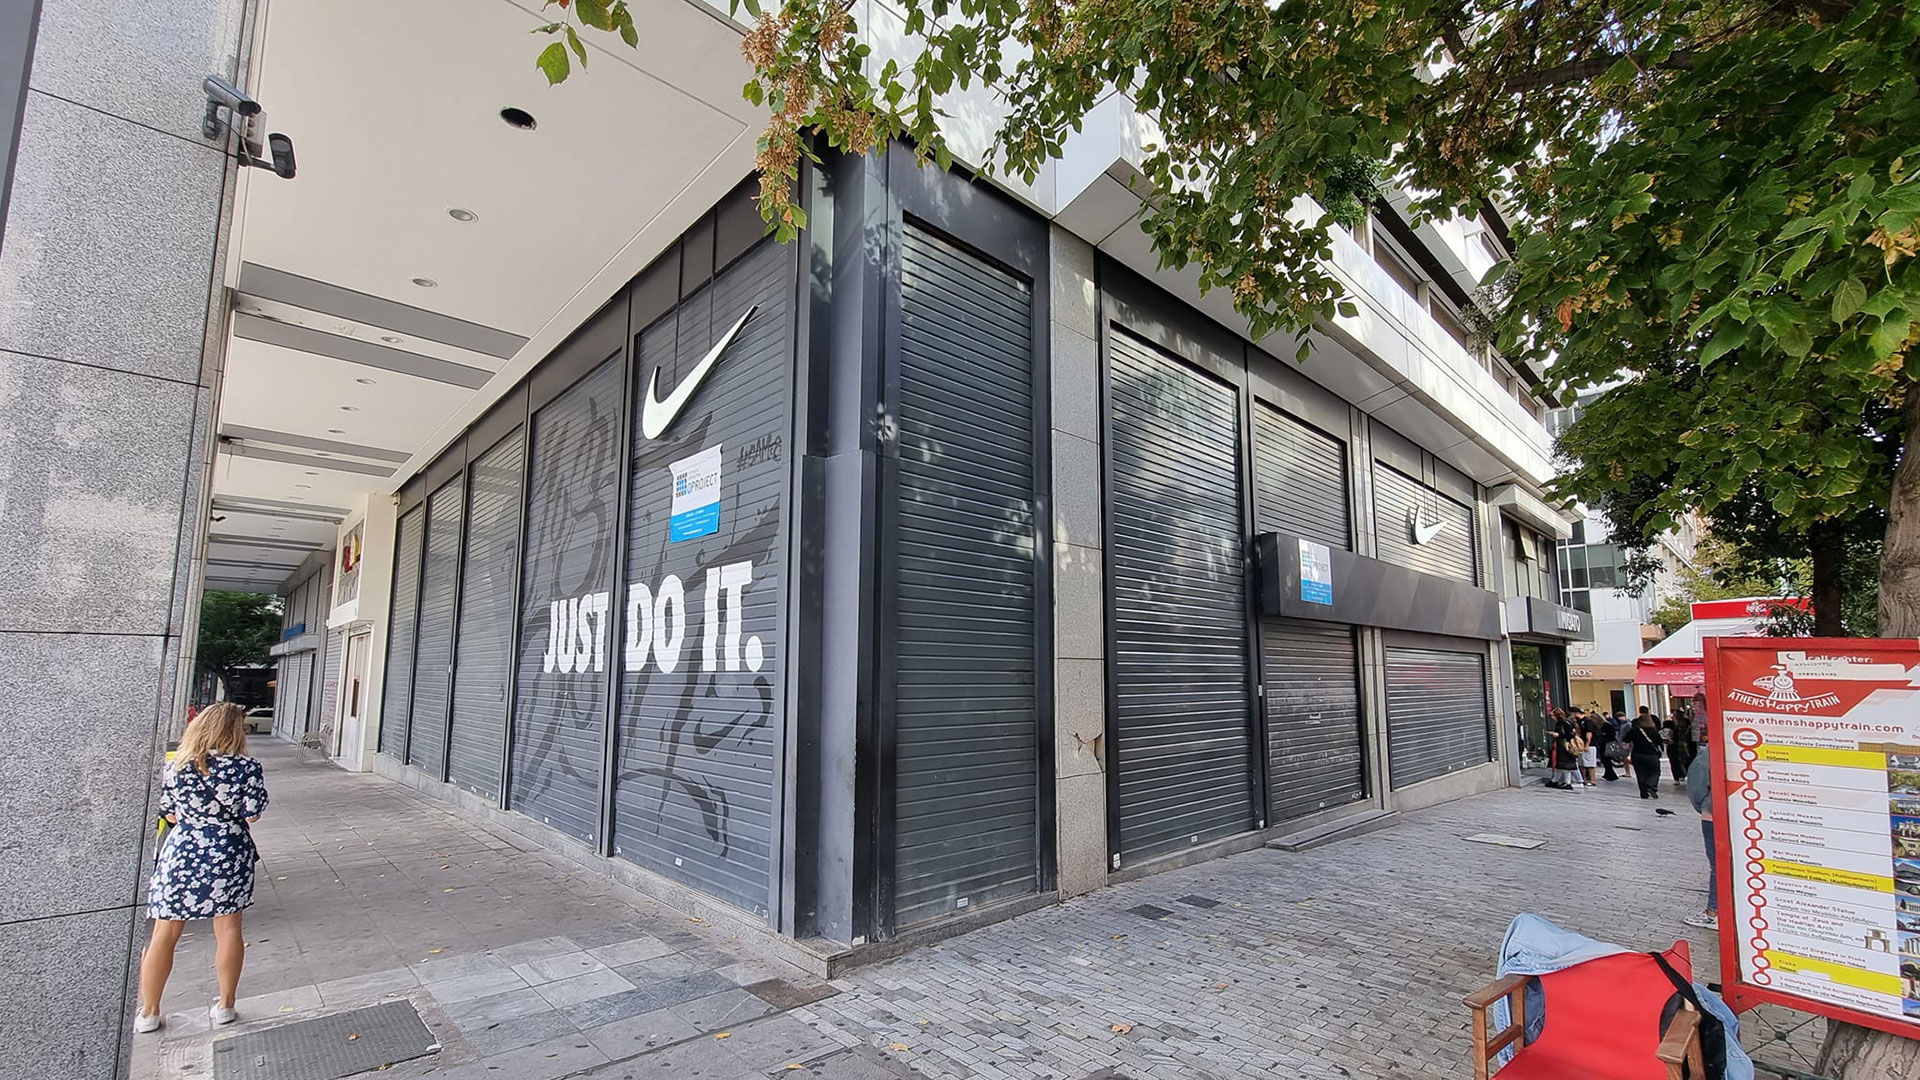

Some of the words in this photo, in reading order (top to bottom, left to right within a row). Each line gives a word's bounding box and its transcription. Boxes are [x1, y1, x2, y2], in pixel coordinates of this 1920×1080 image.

[544, 592, 610, 674] JUST
[626, 574, 686, 674] DO
[702, 561, 763, 672] IT.
[1727, 691, 1765, 708] ATHENS
[1766, 700, 1810, 713] Happy
[1809, 695, 1841, 708] TRAIN
[1726, 716, 1904, 734] www.athenshappytrain.com
